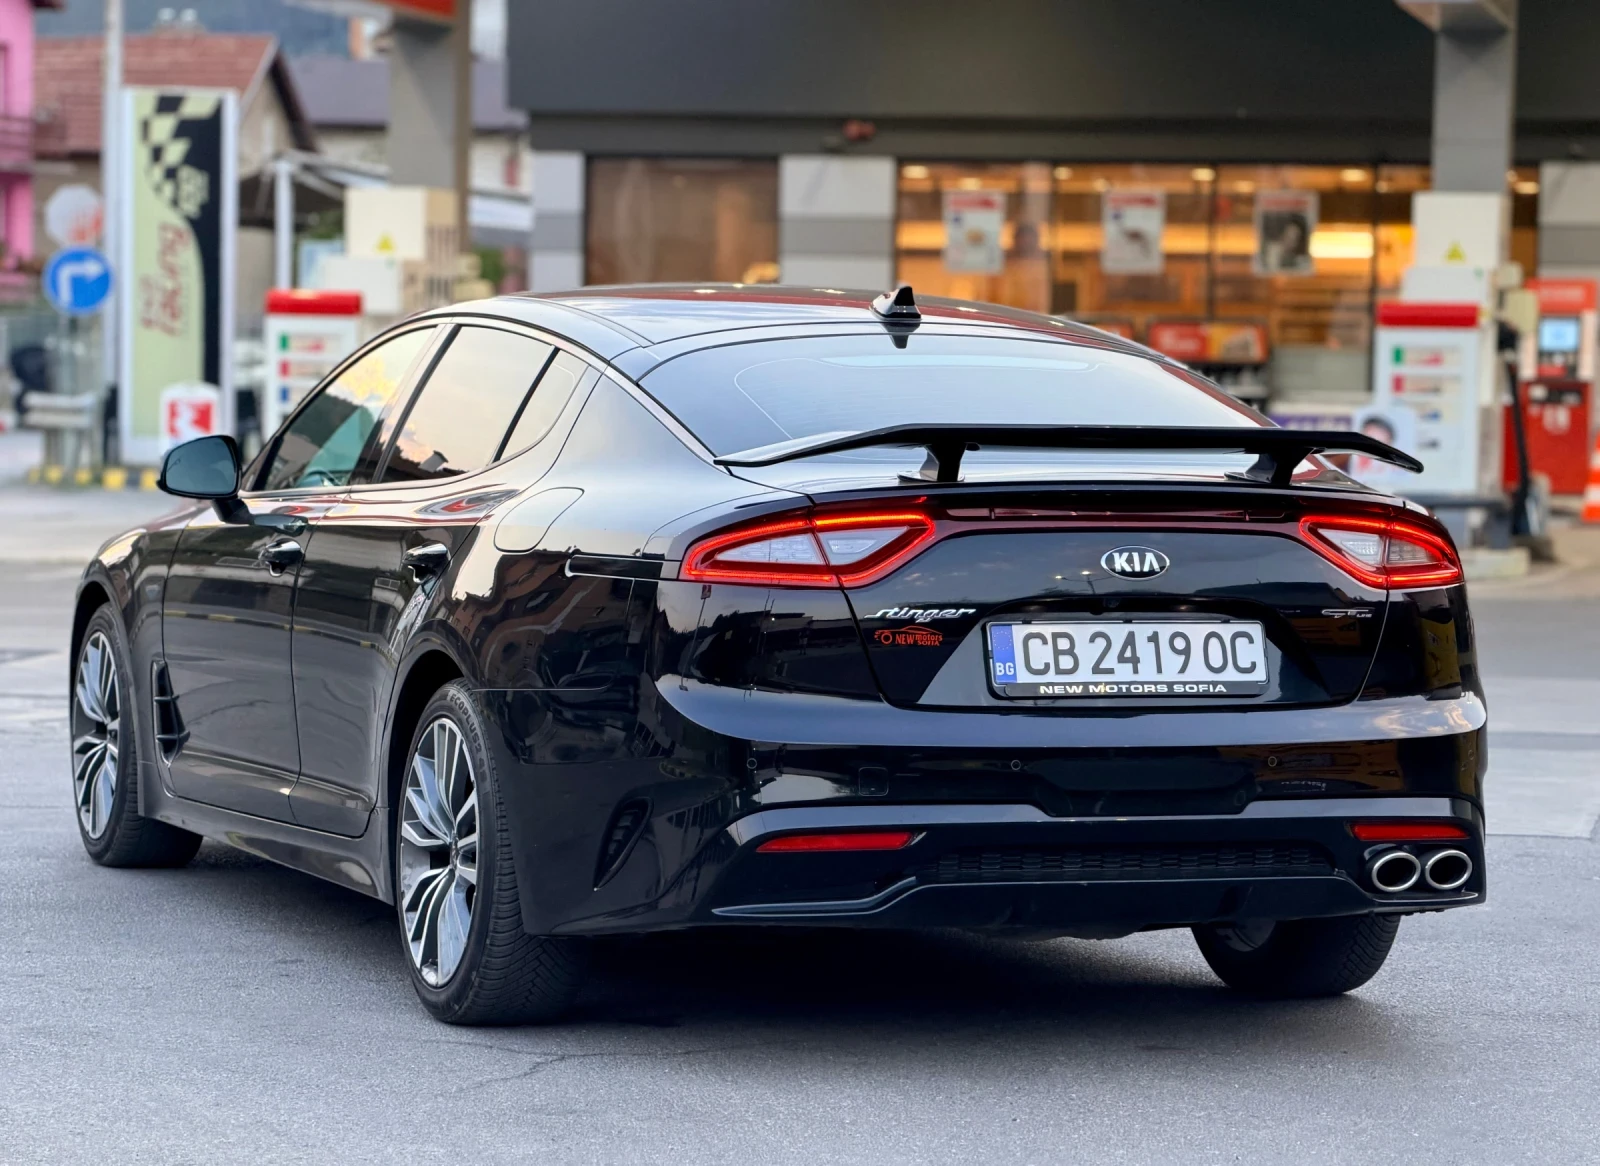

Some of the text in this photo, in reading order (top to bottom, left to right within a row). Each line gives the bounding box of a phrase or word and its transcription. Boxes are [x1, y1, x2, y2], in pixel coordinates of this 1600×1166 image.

[1112, 552, 1160, 572] KIA
[895, 633, 915, 645] NEW
[1022, 631, 1258, 675] CB 2419 OC
[996, 662, 1015, 676] BG
[1039, 683, 1227, 694] NEW MOTORS SOFIA
[450, 693, 482, 753] ECOPLUS2
